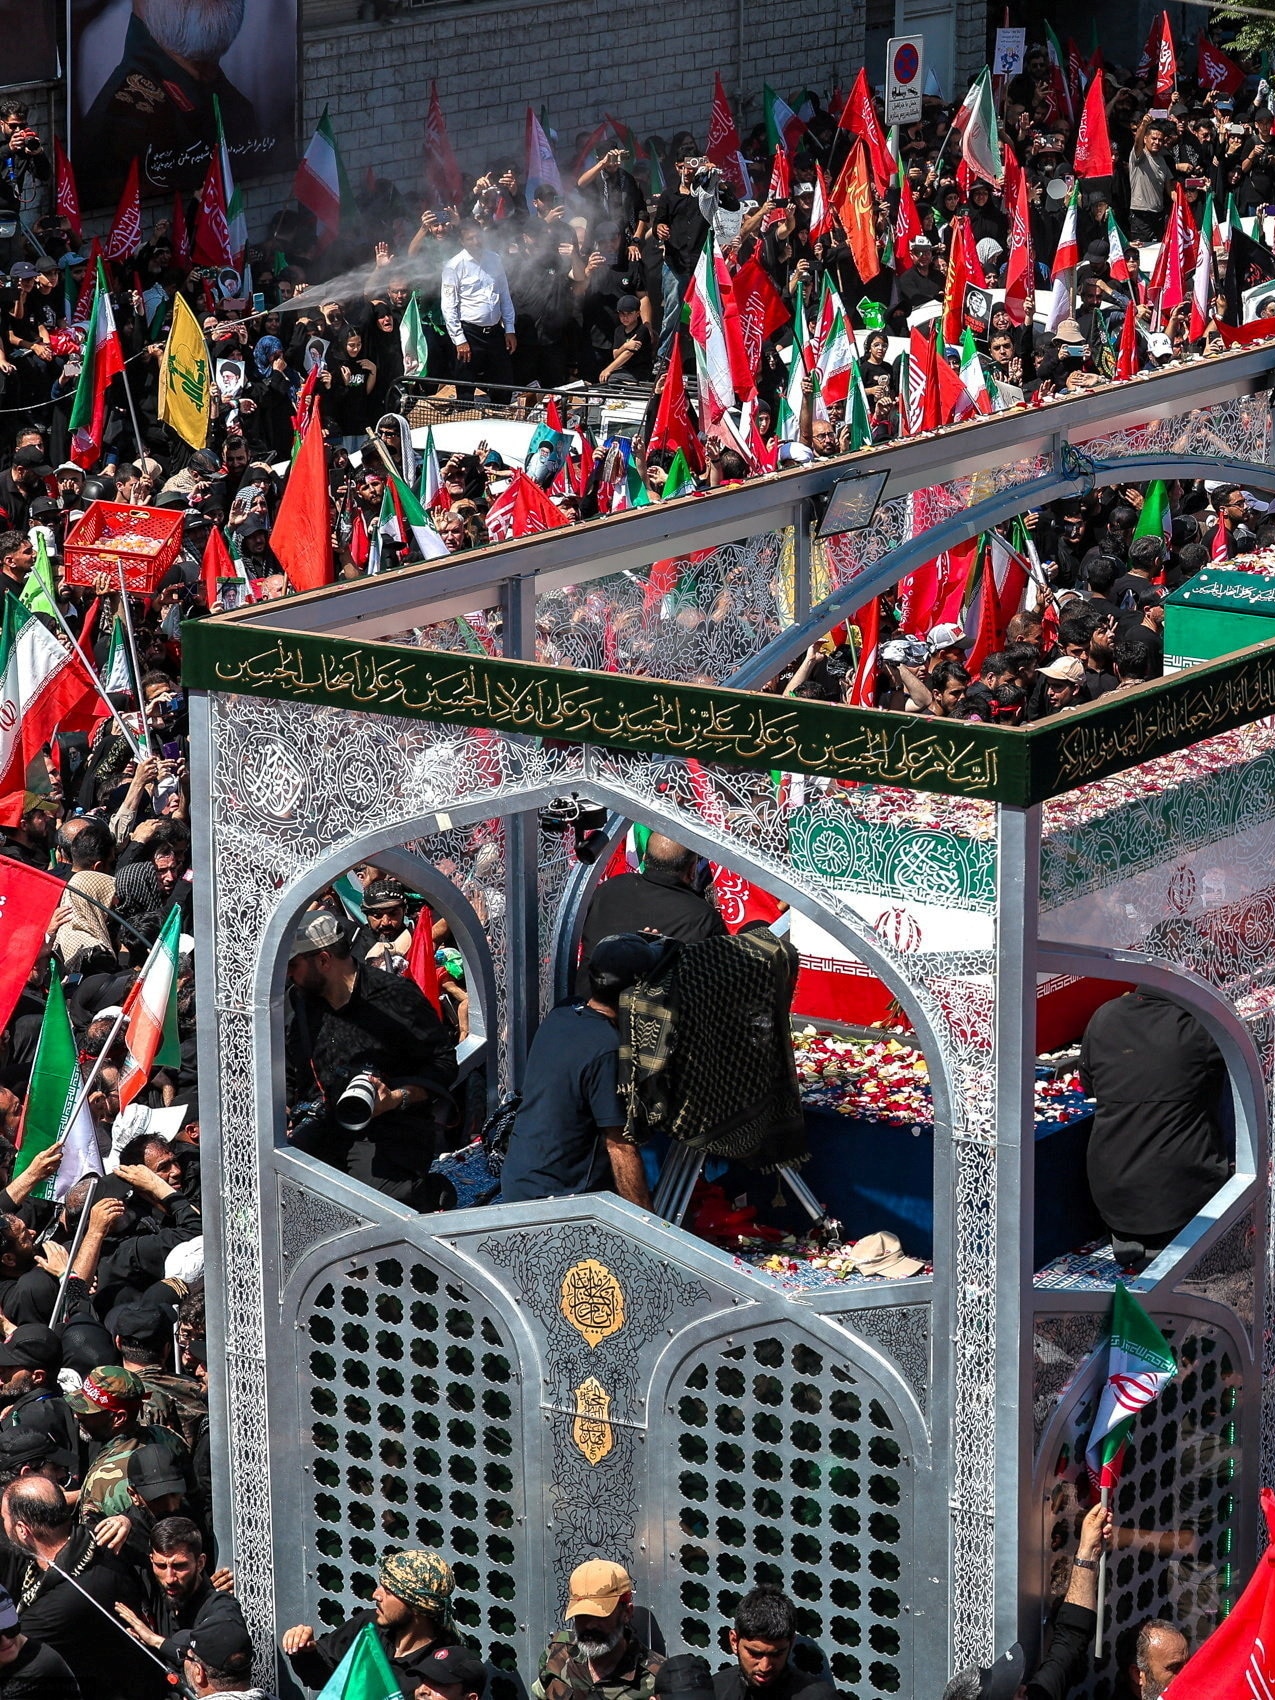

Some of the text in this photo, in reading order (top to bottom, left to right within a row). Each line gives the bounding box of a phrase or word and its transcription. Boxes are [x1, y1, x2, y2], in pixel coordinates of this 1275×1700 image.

[215, 638, 303, 689] الحسين
[402, 664, 490, 717] الحسين
[592, 693, 681, 743] الحسين
[798, 724, 890, 776] الحسين
